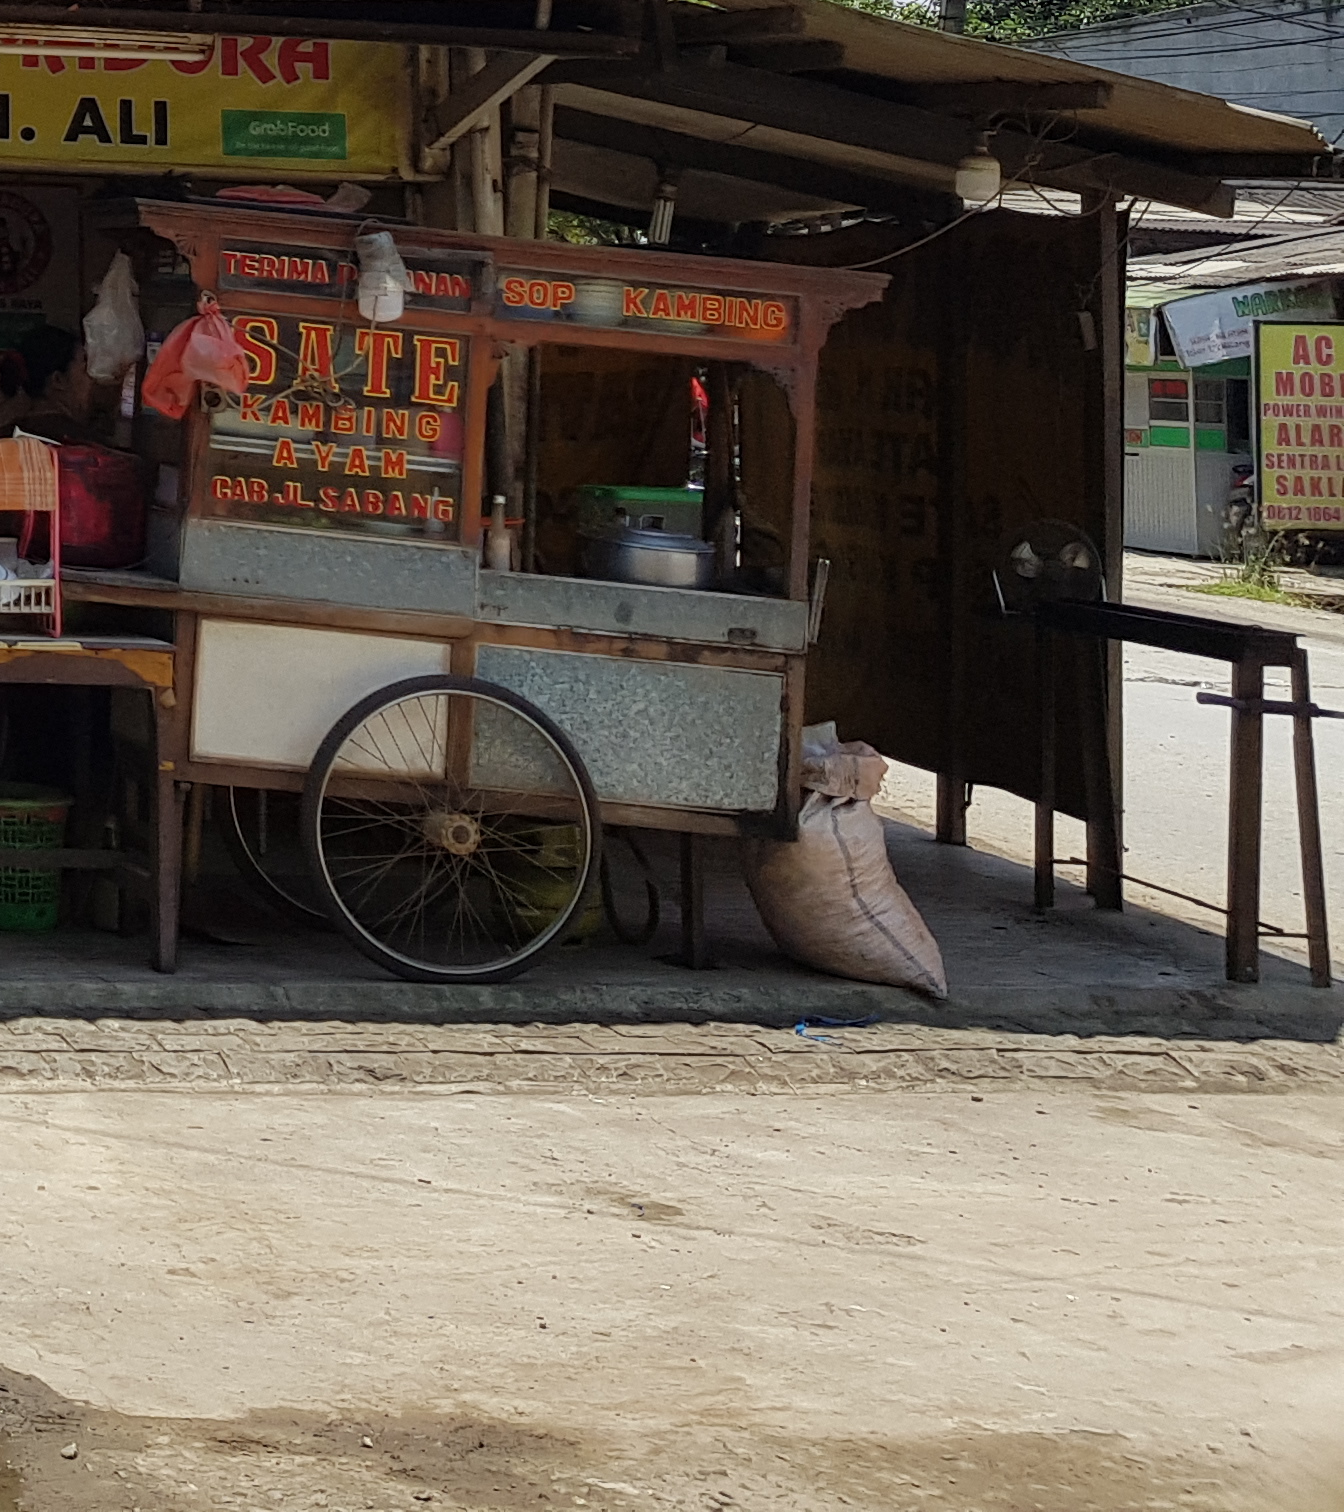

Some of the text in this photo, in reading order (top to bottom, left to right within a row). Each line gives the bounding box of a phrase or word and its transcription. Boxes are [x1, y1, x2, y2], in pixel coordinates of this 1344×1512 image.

[61, 96, 172, 148] ALI
[248, 120, 330, 137] GrabFood
[222, 251, 330, 285] TERIMA
[502, 277, 786, 331] SOP KAMBING
[232, 315, 460, 407] SATE
[1292, 334, 1334, 367] AC
[240, 393, 441, 442] KAMBING
[1263, 402, 1312, 418] POWER
[272, 437, 407, 479] AYAM
[1265, 452, 1331, 471] SENTRA
[1275, 474, 1344, 498] SAKL
[319, 486, 455, 523] SABANG
